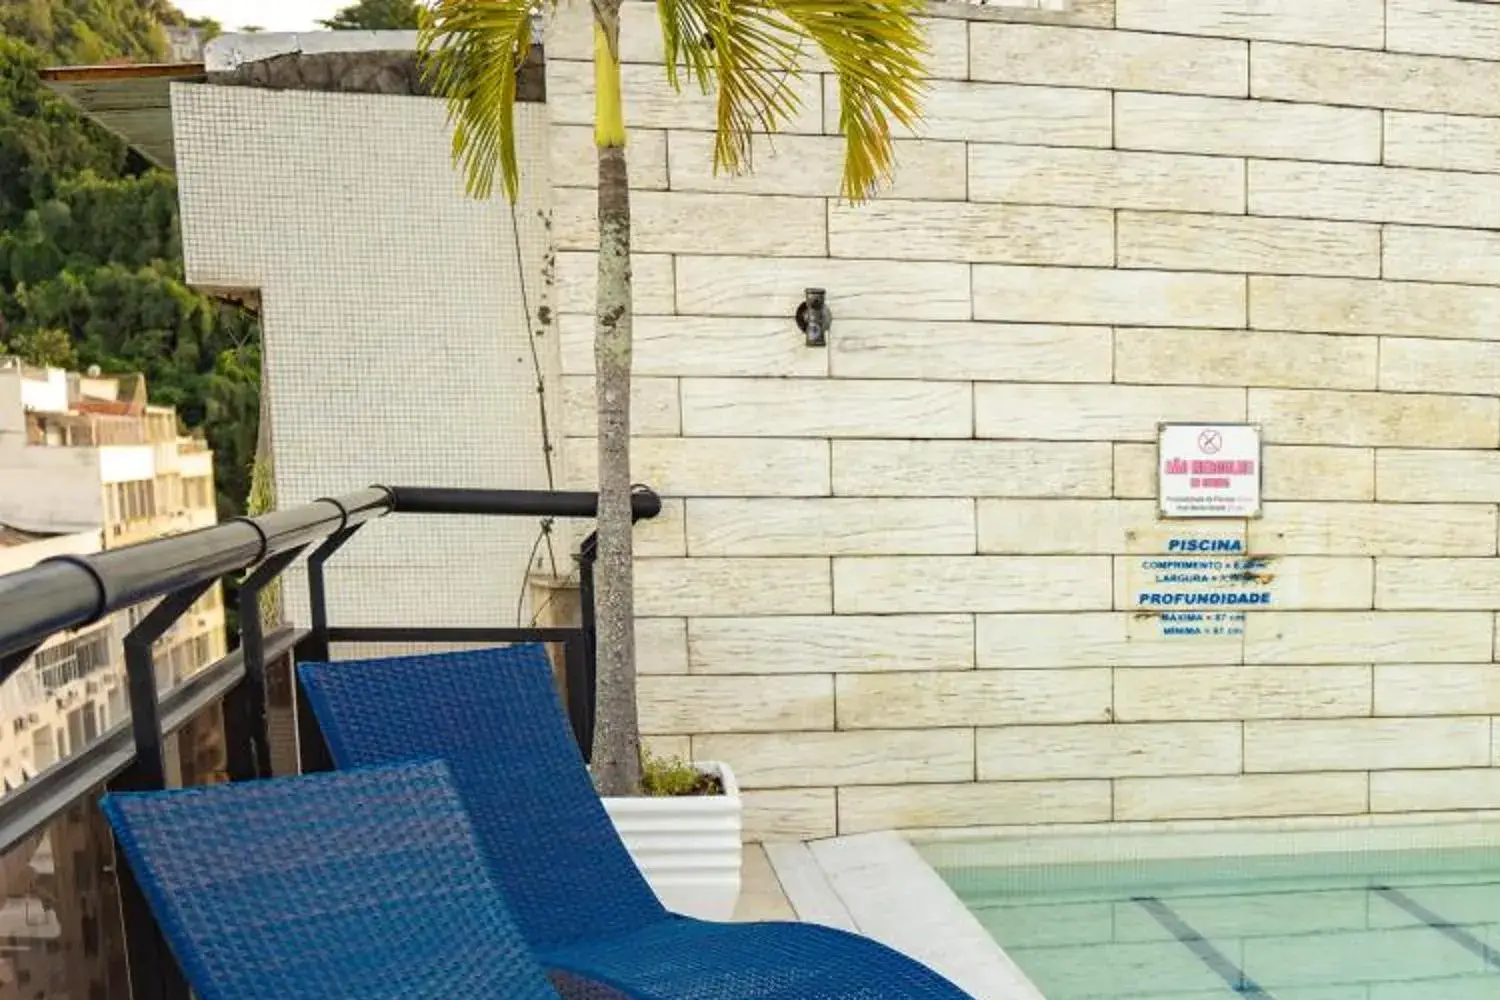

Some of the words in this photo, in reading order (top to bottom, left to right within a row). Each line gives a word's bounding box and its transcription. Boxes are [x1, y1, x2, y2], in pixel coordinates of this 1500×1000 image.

[1168, 539, 1242, 551] PISCINA
[1141, 561, 1223, 570] COMPRIMENTO
[1155, 573, 1209, 583] LARGURA
[1139, 593, 1272, 605] PROFUNDIDADE
